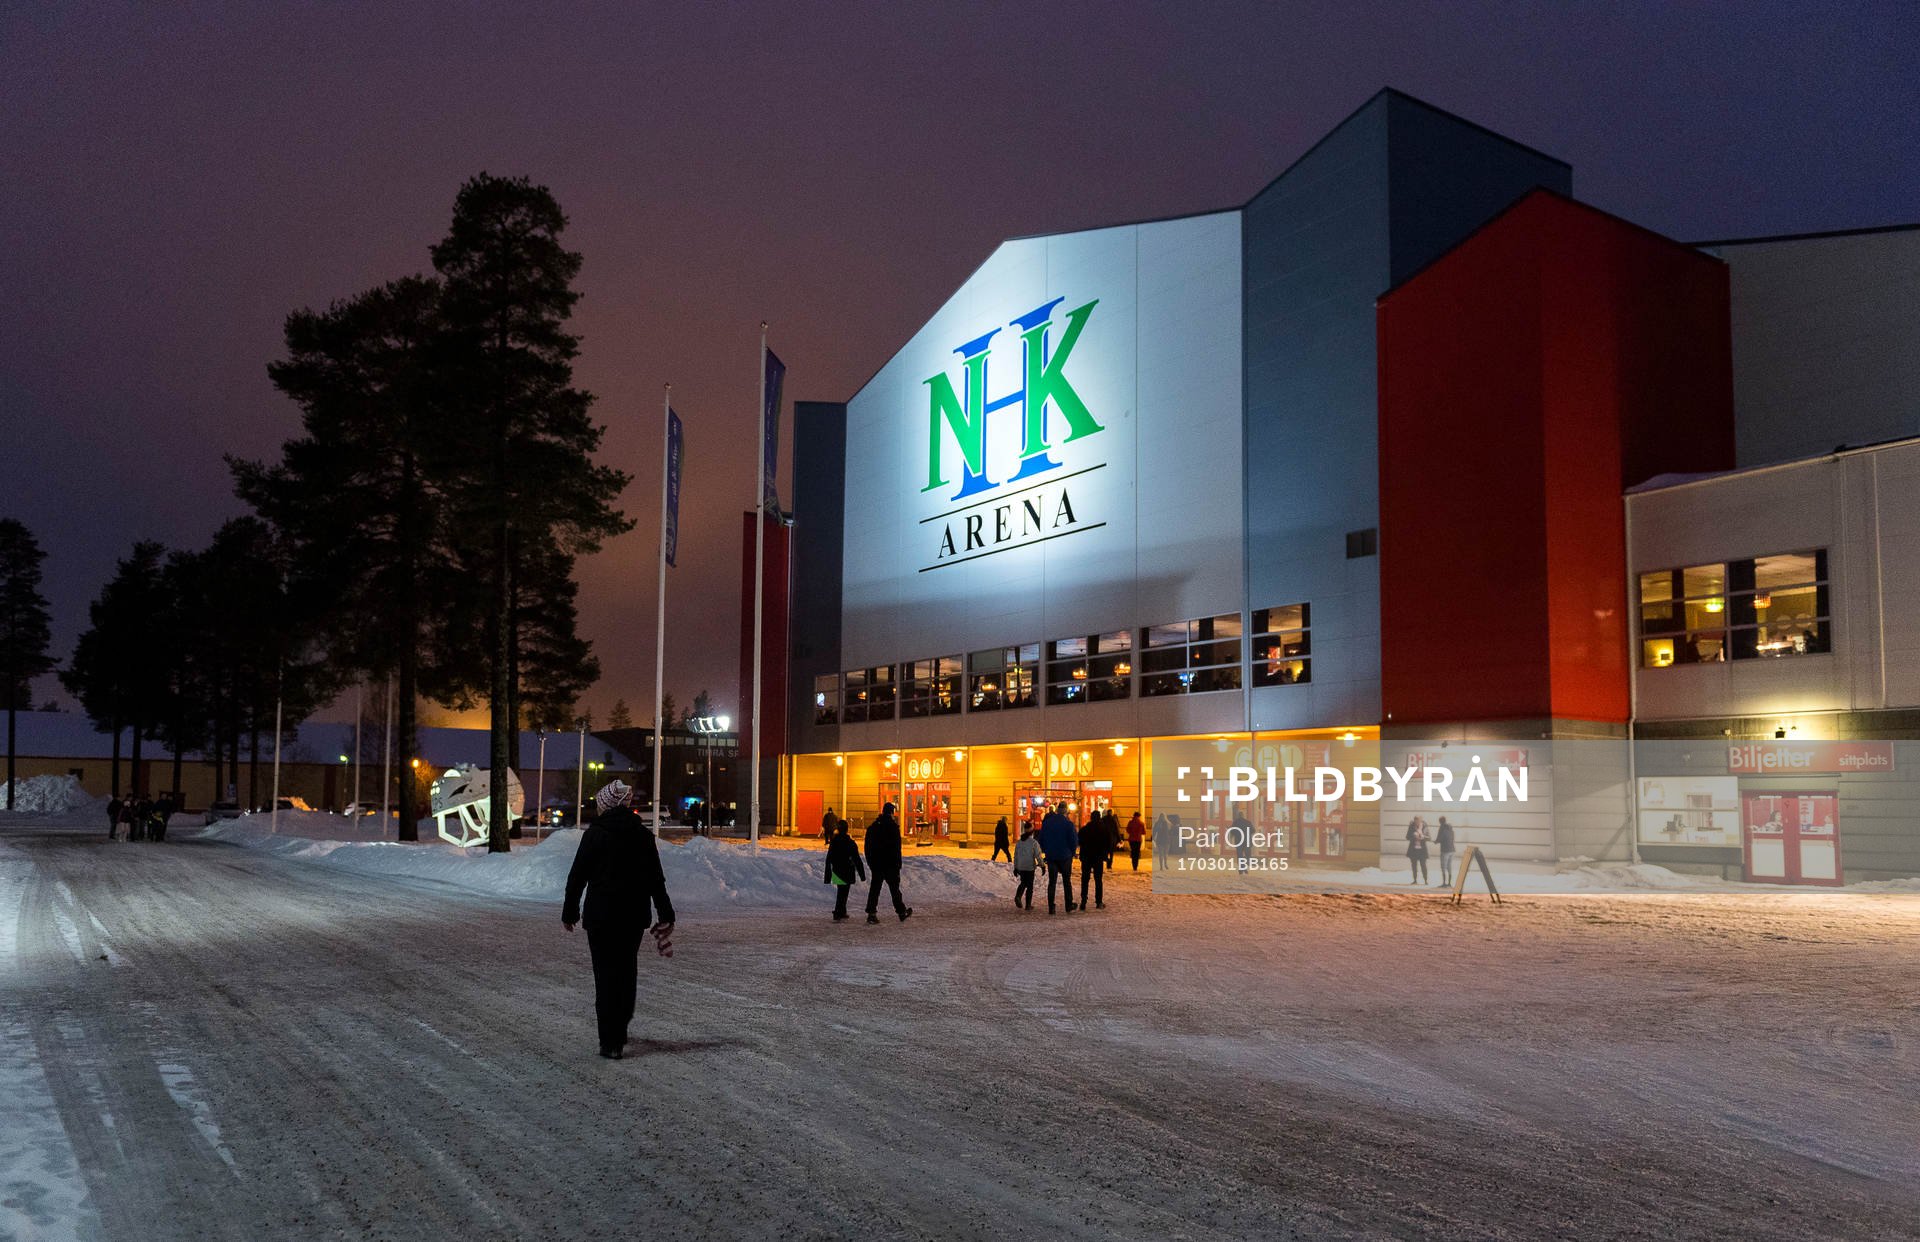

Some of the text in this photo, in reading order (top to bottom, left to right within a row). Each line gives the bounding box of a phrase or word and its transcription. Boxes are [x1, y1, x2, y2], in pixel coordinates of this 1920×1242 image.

[921, 296, 1105, 501] NHK
[937, 487, 1078, 559] ARENA
[1729, 746, 1888, 773] Biljetter sittplats
